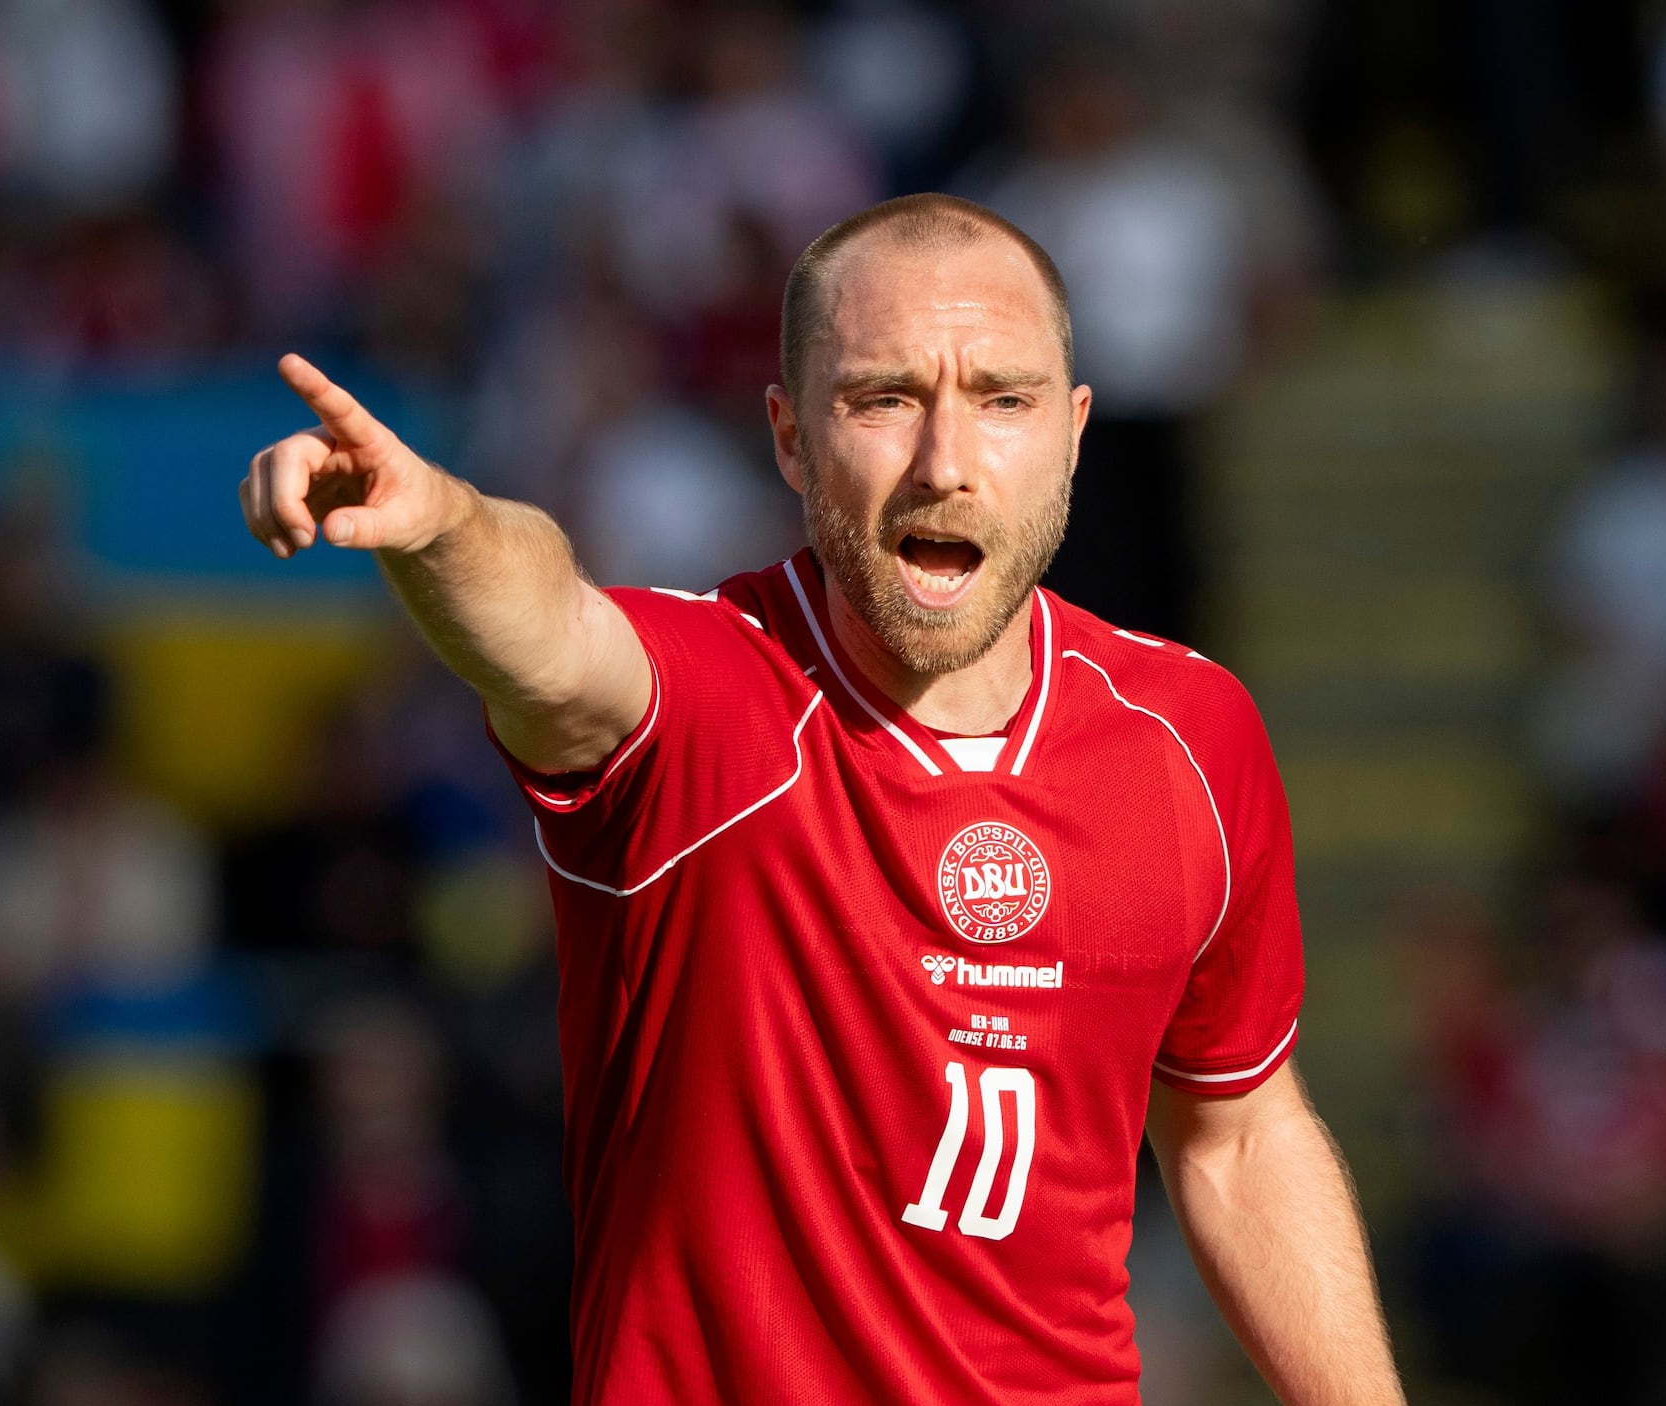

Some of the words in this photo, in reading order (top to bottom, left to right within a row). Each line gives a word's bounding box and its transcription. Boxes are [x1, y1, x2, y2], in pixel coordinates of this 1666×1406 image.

[942, 859, 972, 930] DANSK
[973, 922, 1019, 941] 1889
[960, 862, 1028, 900] DBU
[957, 957, 1064, 989] hummel
[948, 1028, 984, 1046] ODENSE
[985, 1032, 1027, 1050] 07.06.26
[901, 1061, 1036, 1241] 10
